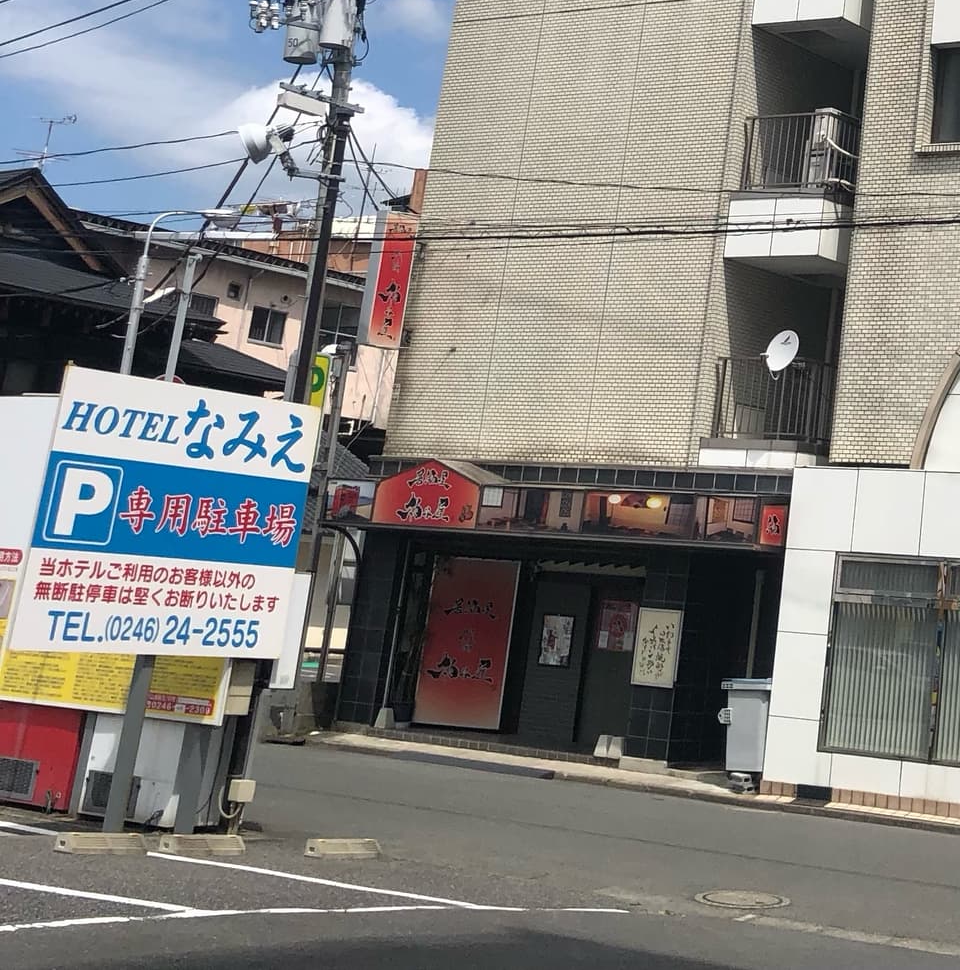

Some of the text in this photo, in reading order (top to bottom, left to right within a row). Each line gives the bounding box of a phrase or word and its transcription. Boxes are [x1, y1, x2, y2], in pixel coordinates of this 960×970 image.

[62, 399, 306, 473] HOTEL なみえ
[53, 468, 297, 548] P 専用駐車場
[33, 580, 280, 613] 無断駐停車は堅くお断りいたします
[39, 557, 256, 590] 当ホテルご利用のお客様以外の
